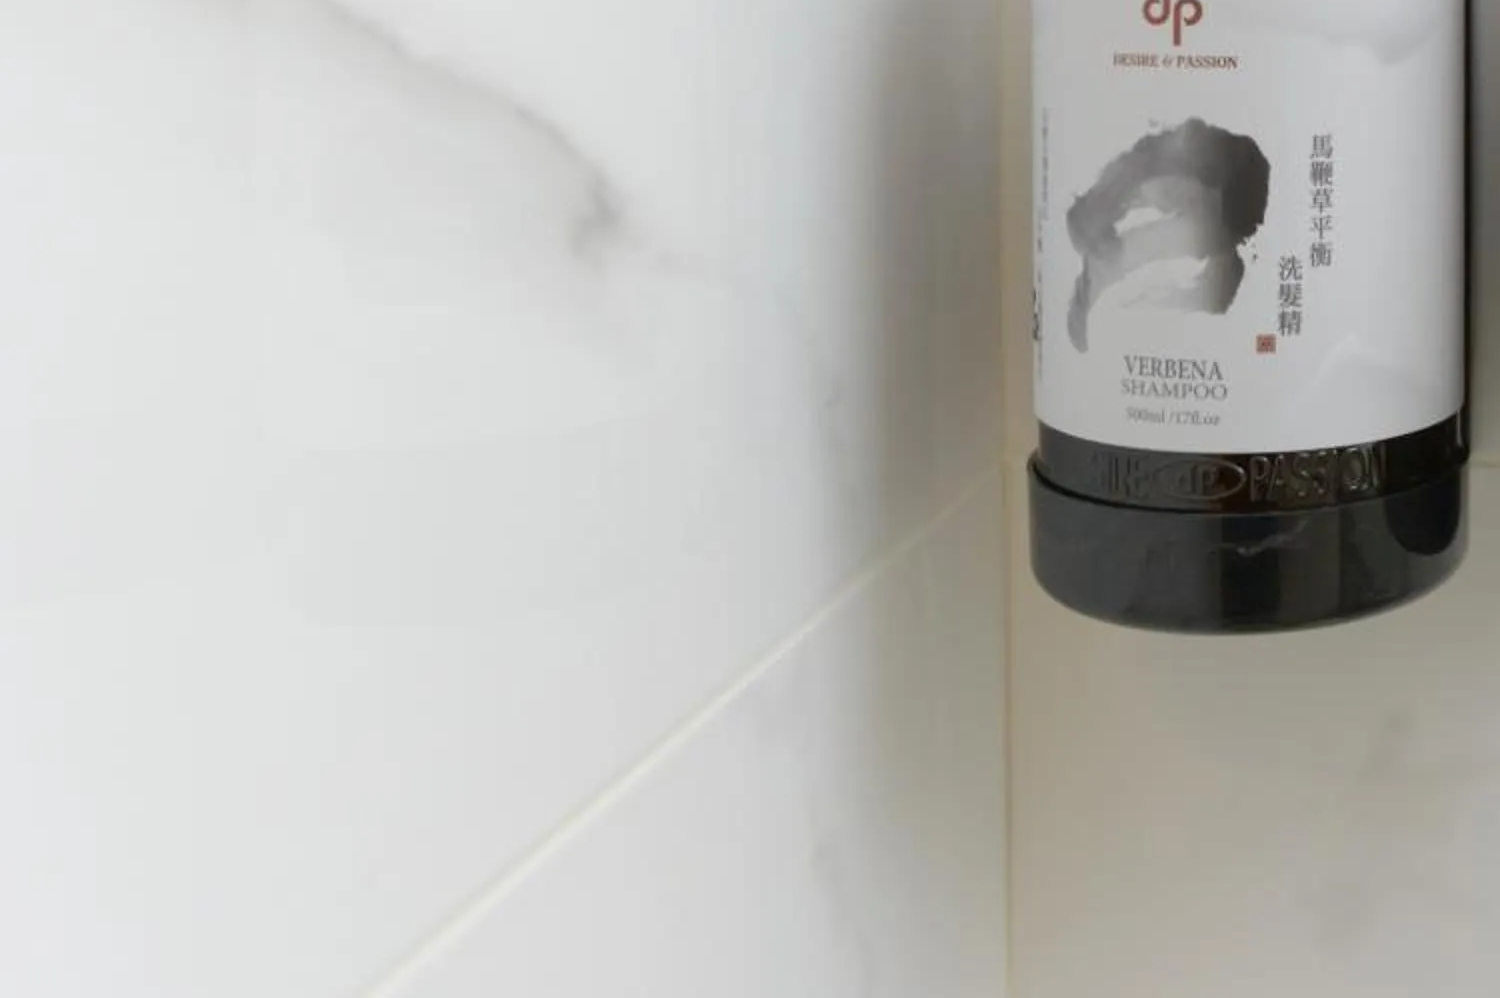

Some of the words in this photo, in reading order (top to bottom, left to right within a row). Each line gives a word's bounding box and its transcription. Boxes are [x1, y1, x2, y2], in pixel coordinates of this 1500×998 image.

[1113, 53, 1159, 66] DESIRE
[1177, 55, 1238, 69] PASSION
[1310, 134, 1333, 267] 馬鞭草平衡
[1278, 255, 1302, 336] 洗髮精
[1124, 355, 1224, 380] VERBENA
[1121, 380, 1227, 401] SHAMPOO
[1126, 407, 1165, 423] 500ml
